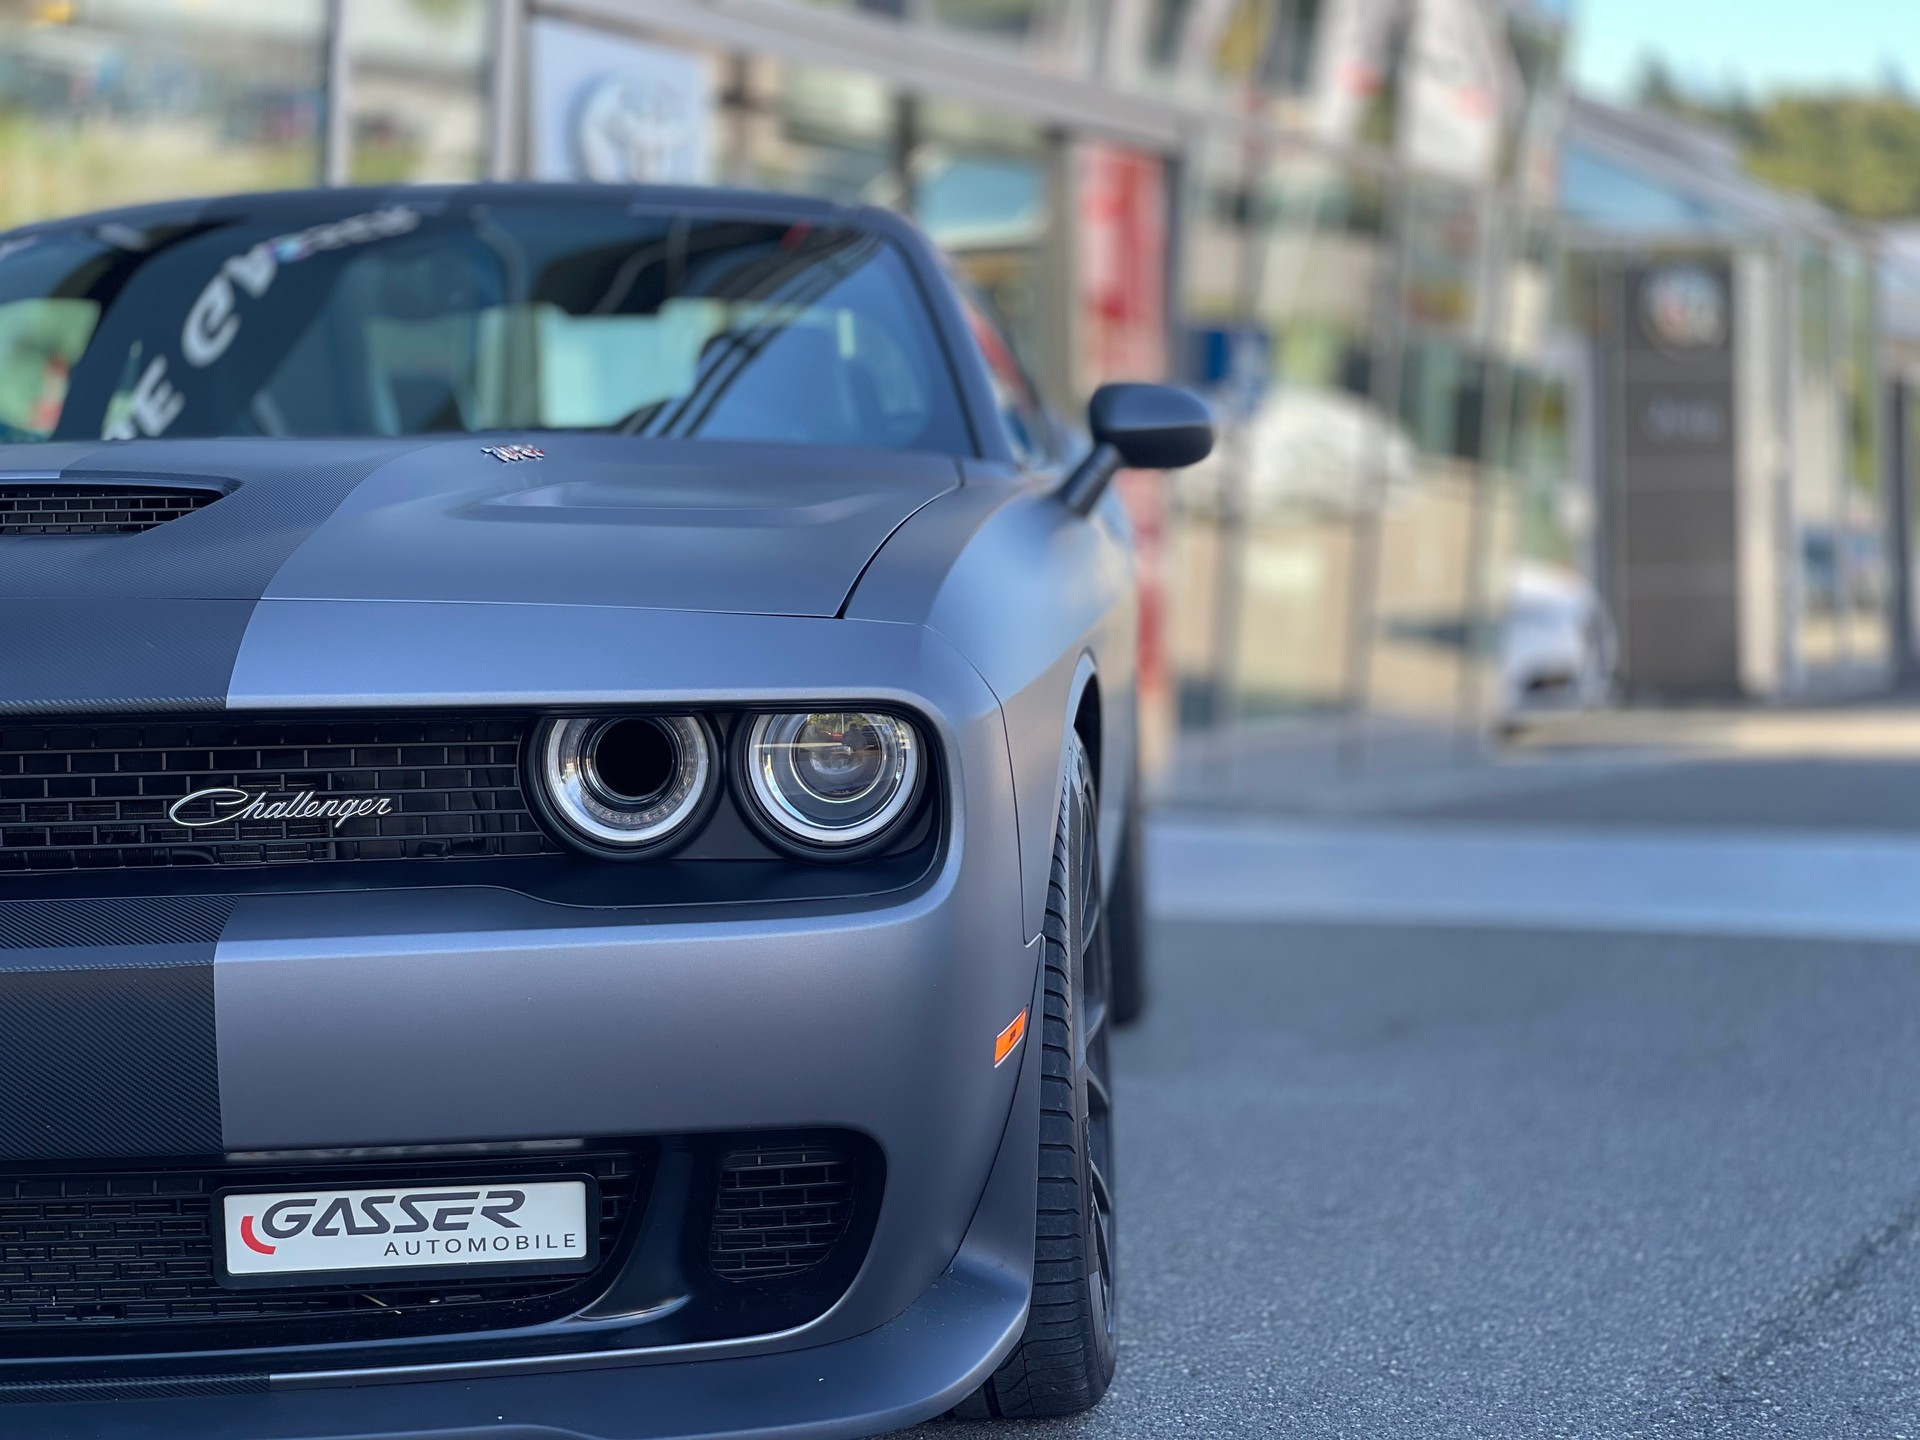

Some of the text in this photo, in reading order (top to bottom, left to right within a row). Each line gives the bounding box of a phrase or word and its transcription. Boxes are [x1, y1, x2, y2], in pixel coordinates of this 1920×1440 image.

[169, 787, 393, 828] Challenger
[261, 1189, 526, 1239] GASSER
[383, 1233, 577, 1257] AUTOMOBILE
